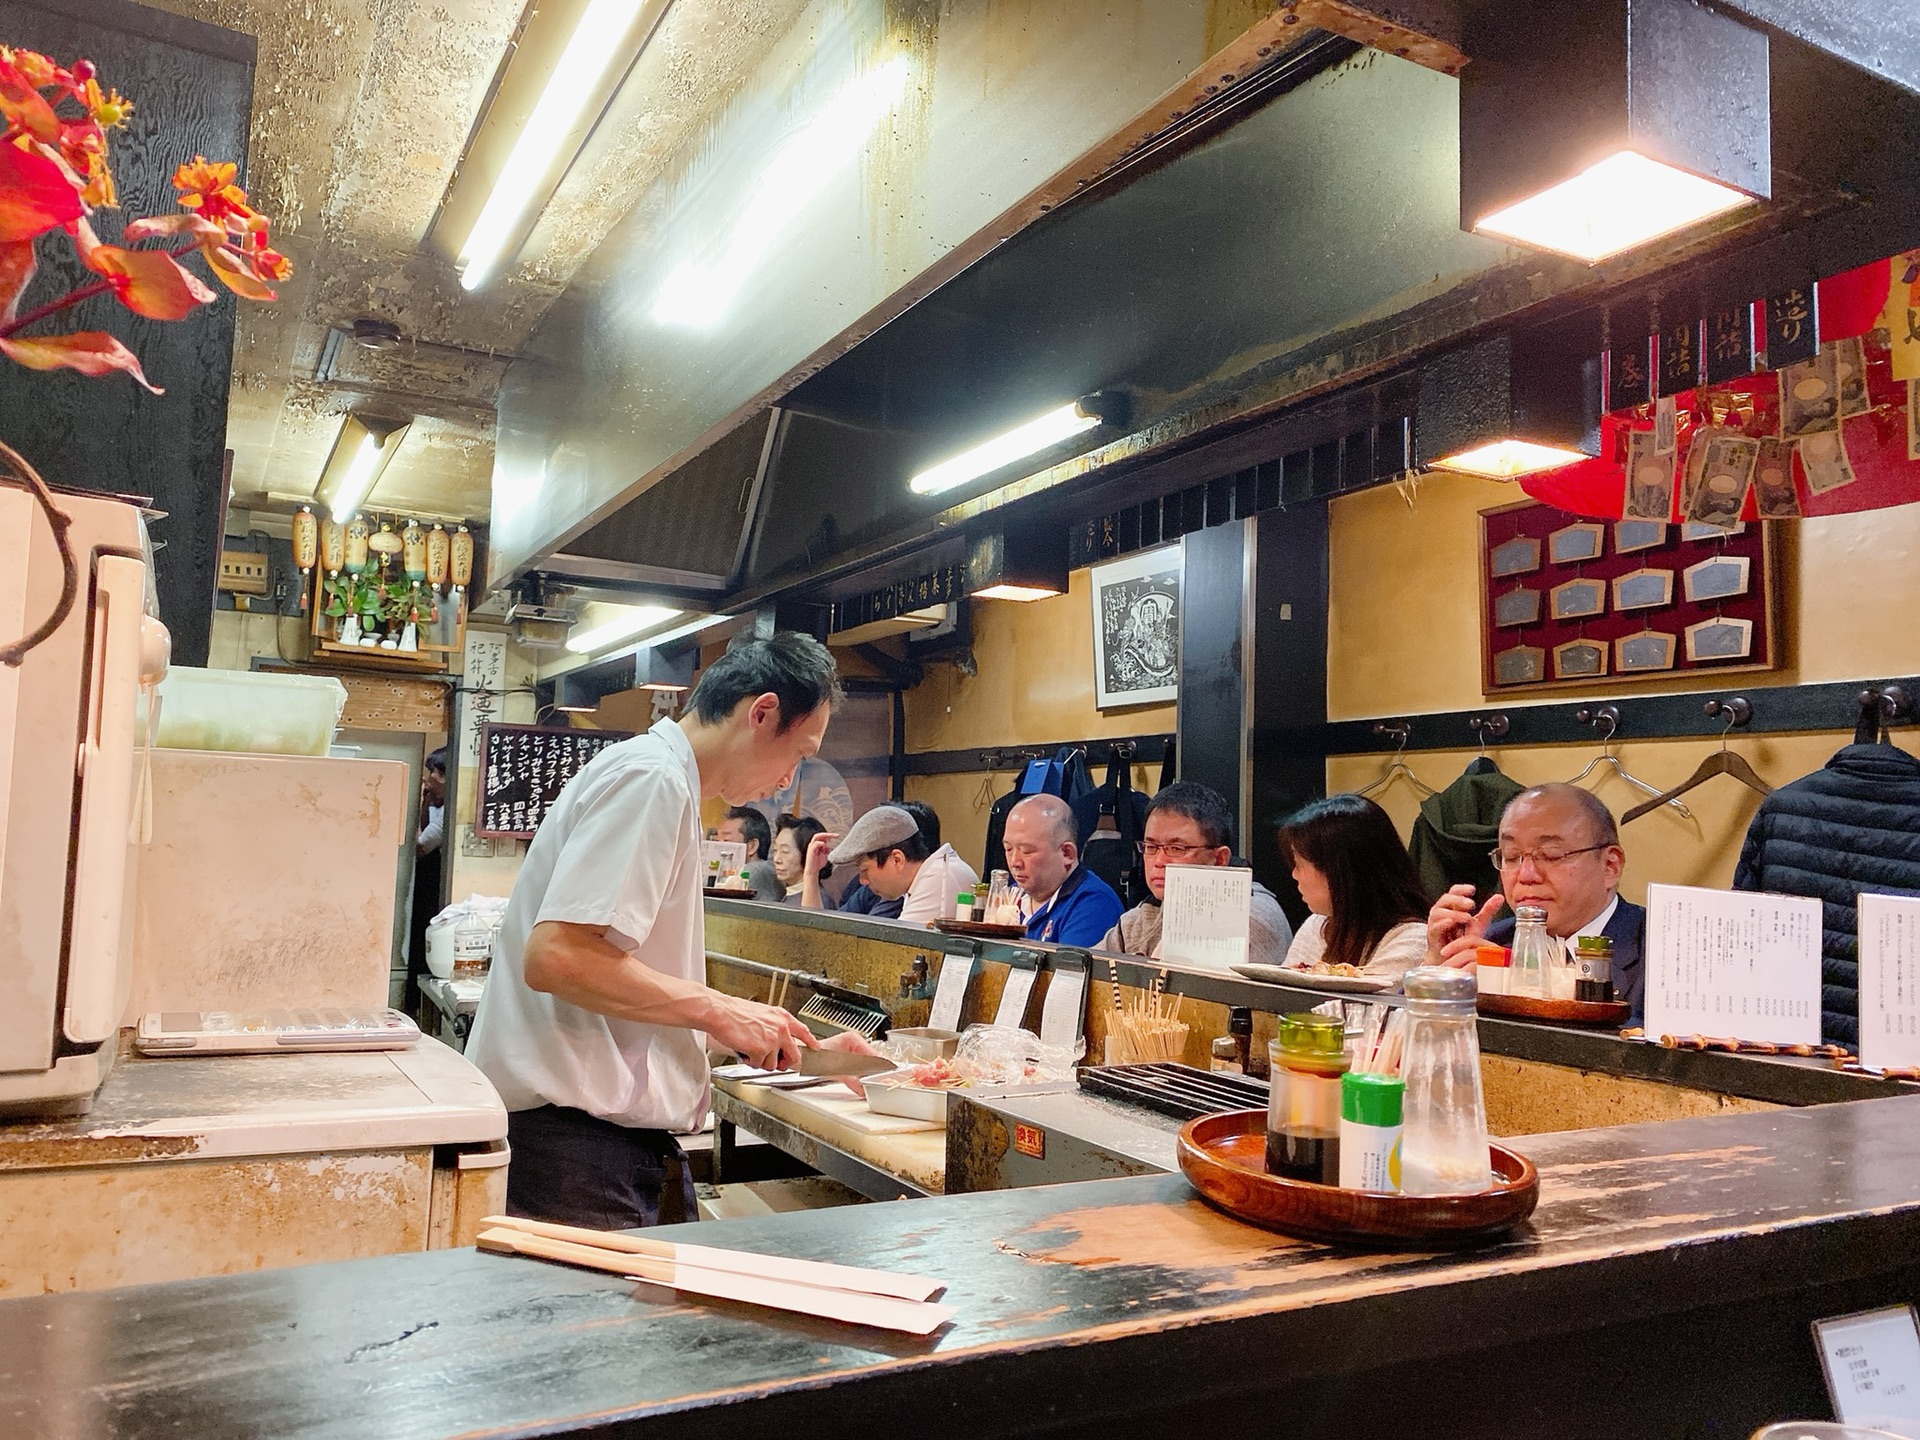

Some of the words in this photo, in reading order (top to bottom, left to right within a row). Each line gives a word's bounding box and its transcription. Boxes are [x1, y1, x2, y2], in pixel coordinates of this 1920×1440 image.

[517, 734, 530, 780] チャンジャ
[544, 736, 561, 789] えびフライ
